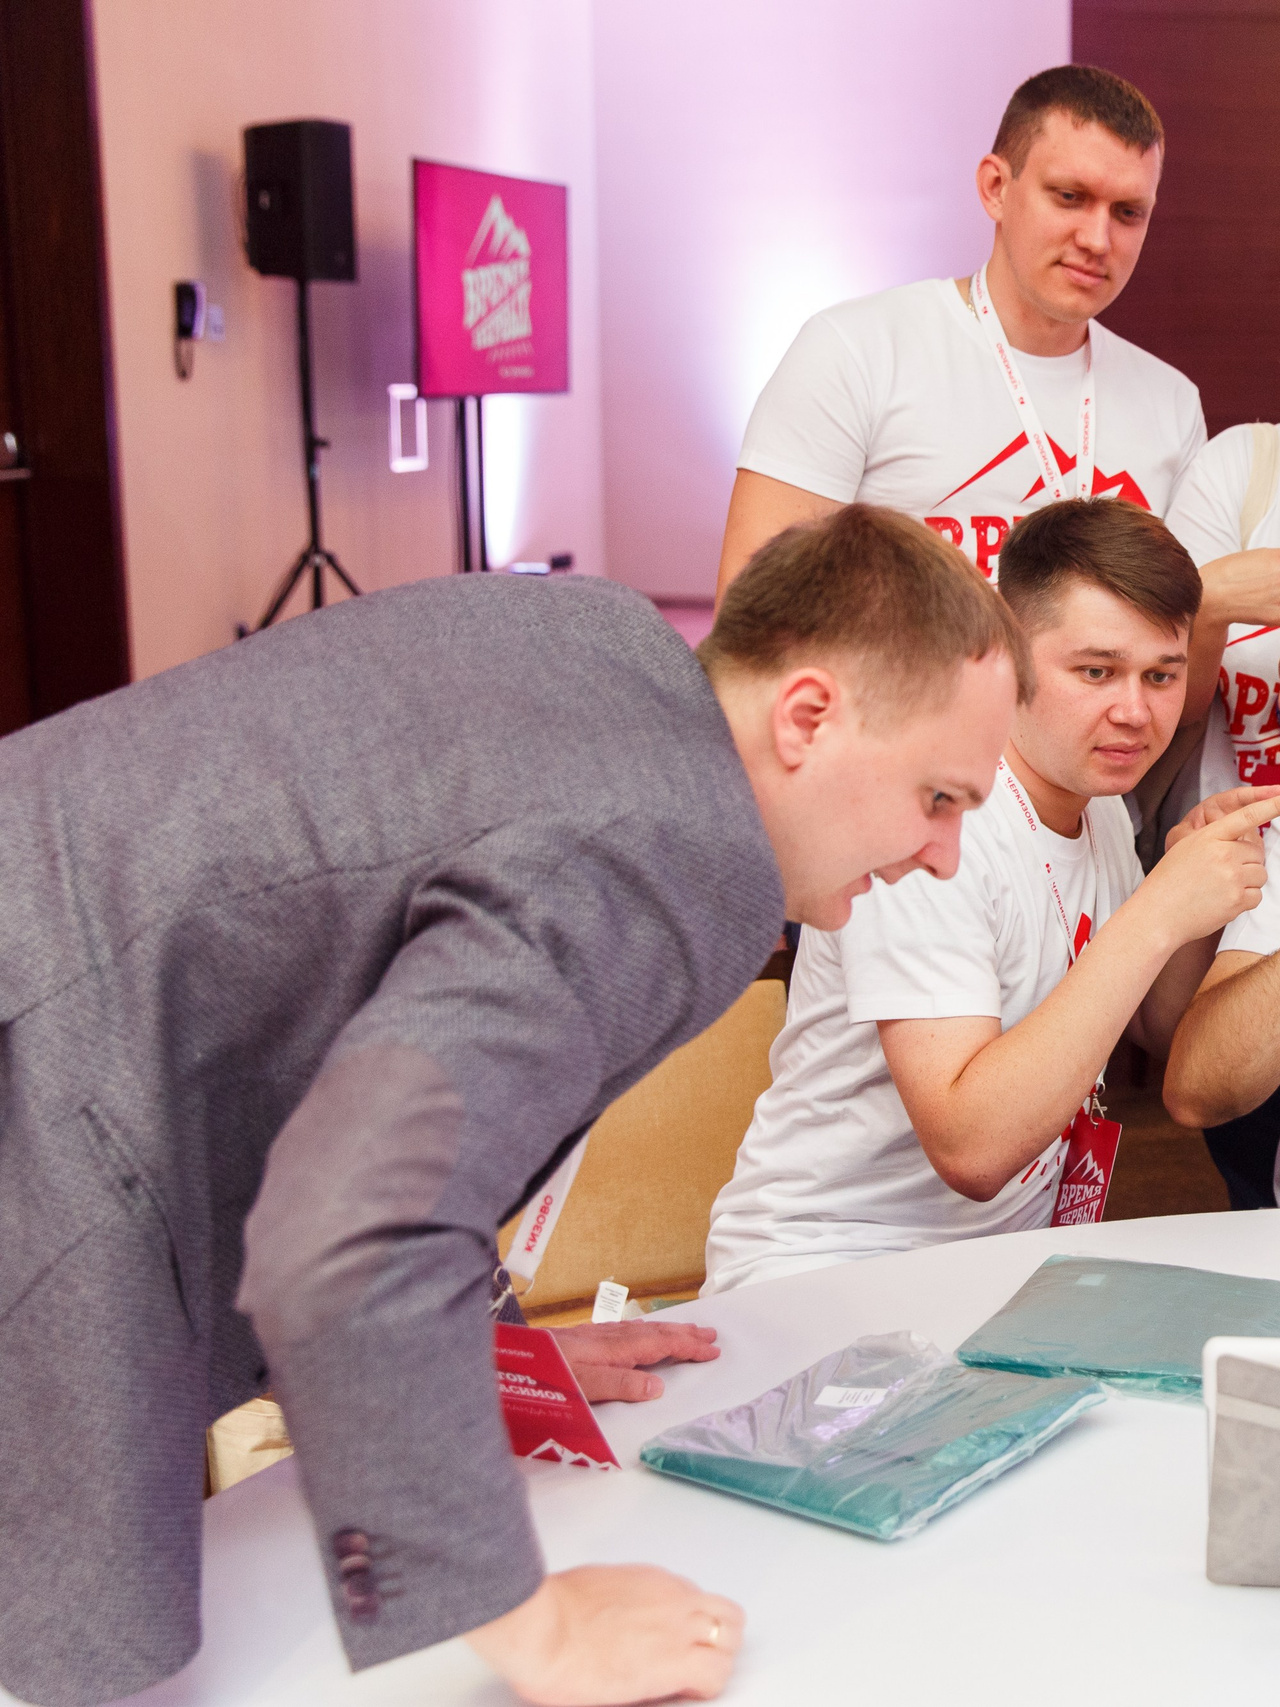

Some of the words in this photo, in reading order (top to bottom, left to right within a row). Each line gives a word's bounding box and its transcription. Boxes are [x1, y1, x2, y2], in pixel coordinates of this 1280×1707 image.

[1006, 776, 1038, 832] ЧЕРКИЗОВО
[1050, 880, 1073, 939] ЧЕРКИЗОВО
[1056, 1183, 1104, 1212] ВРЕМЯ
[1058, 1197, 1102, 1226] ПЕРВЫХ
[524, 1194, 554, 1254] КИЗОВО
[499, 1383, 568, 1403] АСИМОВ
